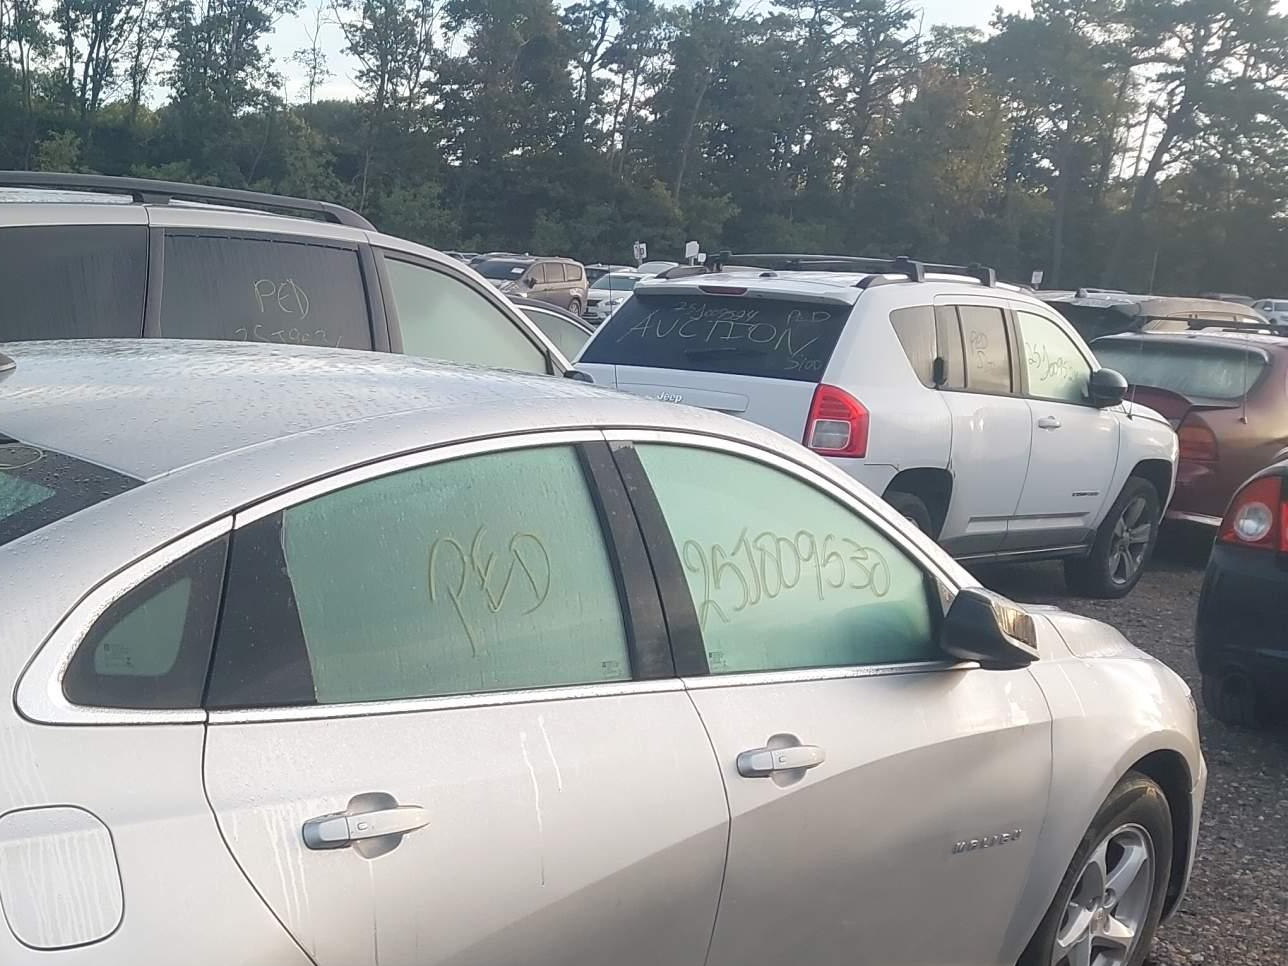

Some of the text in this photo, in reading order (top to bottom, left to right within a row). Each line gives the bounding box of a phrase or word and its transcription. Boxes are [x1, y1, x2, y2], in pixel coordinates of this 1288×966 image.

[253, 278, 309, 320] PED
[616, 309, 818, 357] AUCTION
[657, 391, 683, 403] Jeep
[428, 525, 551, 659] PED
